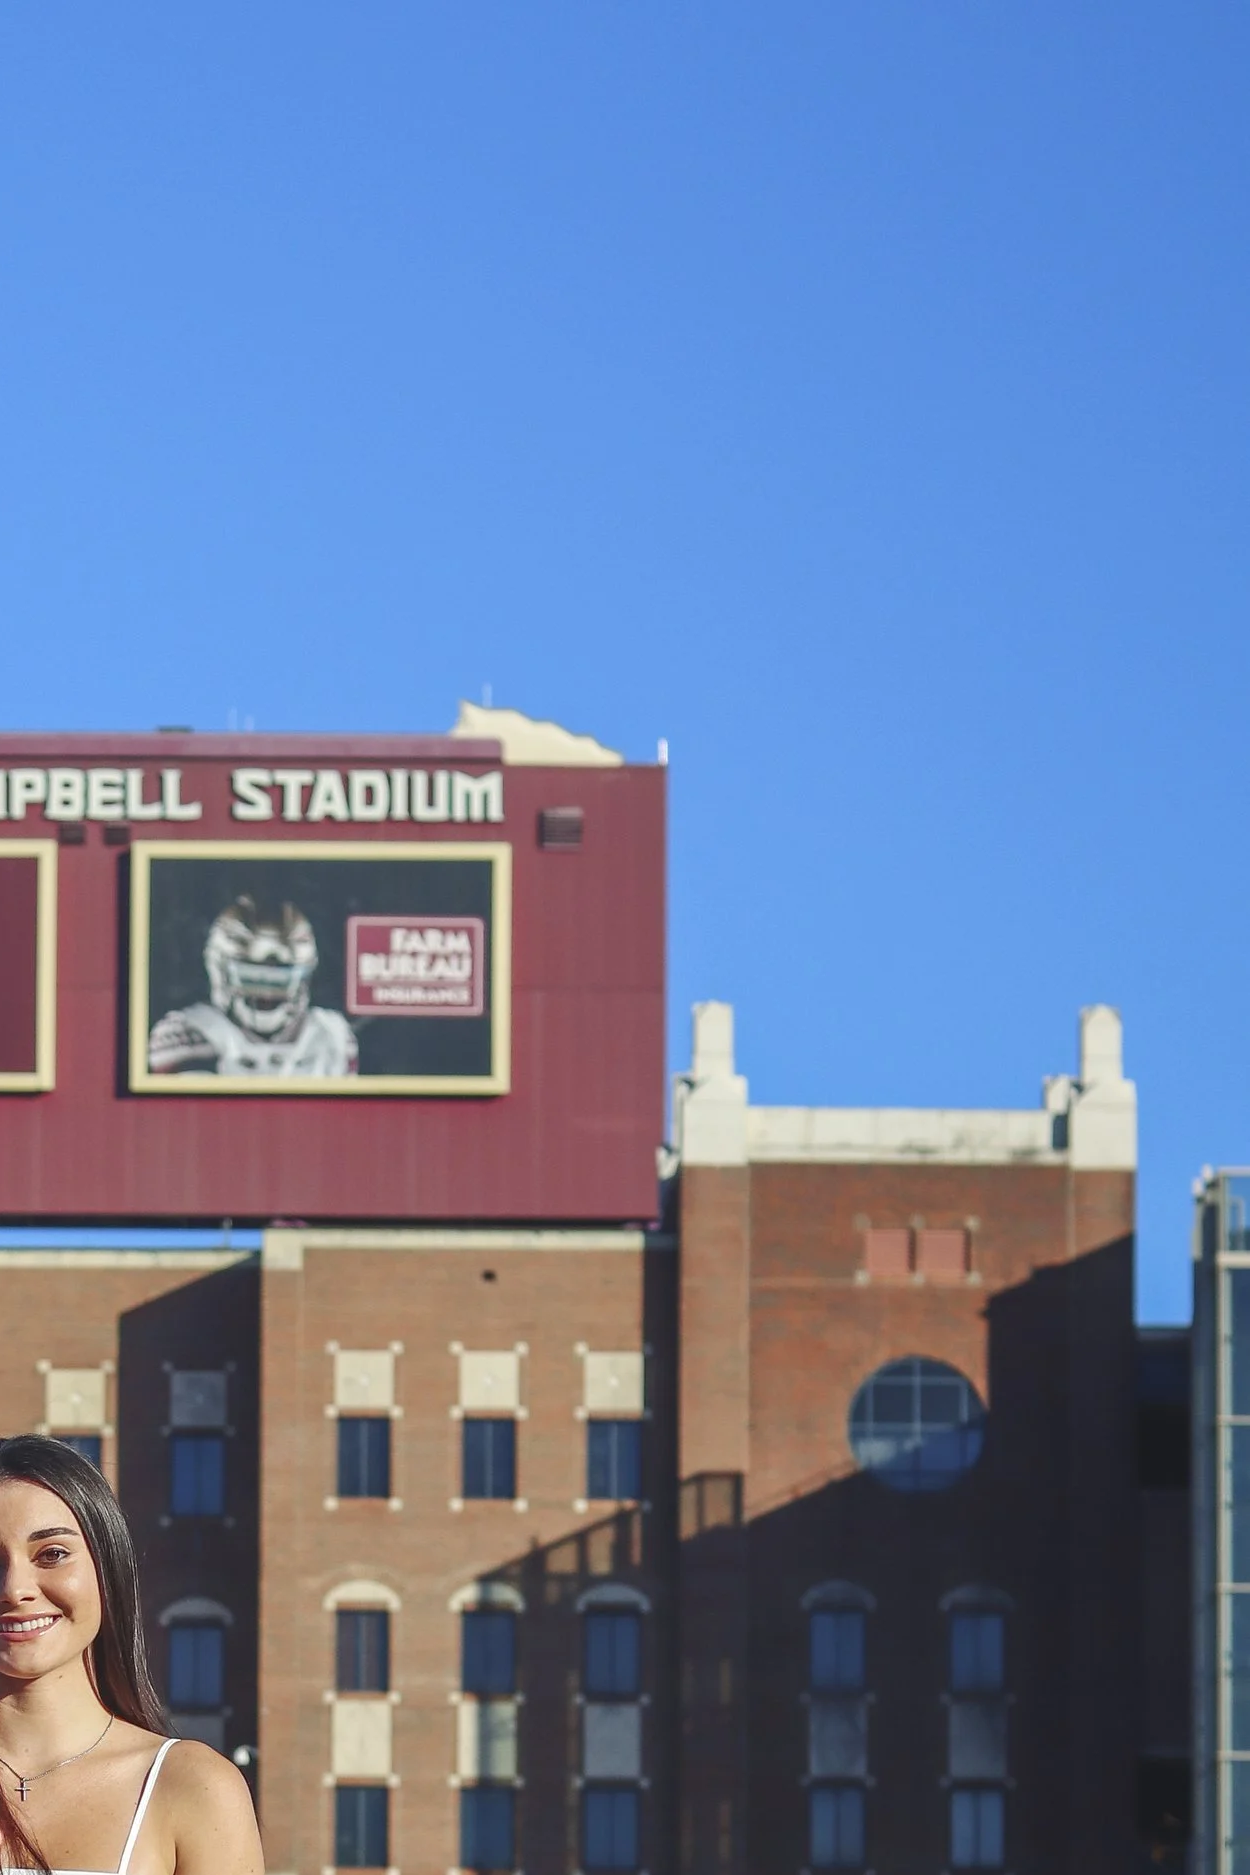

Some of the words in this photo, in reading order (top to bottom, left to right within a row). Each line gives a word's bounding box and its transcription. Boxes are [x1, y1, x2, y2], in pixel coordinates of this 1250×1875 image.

[231, 768, 505, 822] STADIUM
[391, 927, 470, 953] FARM
[359, 953, 471, 981] BUREAU
